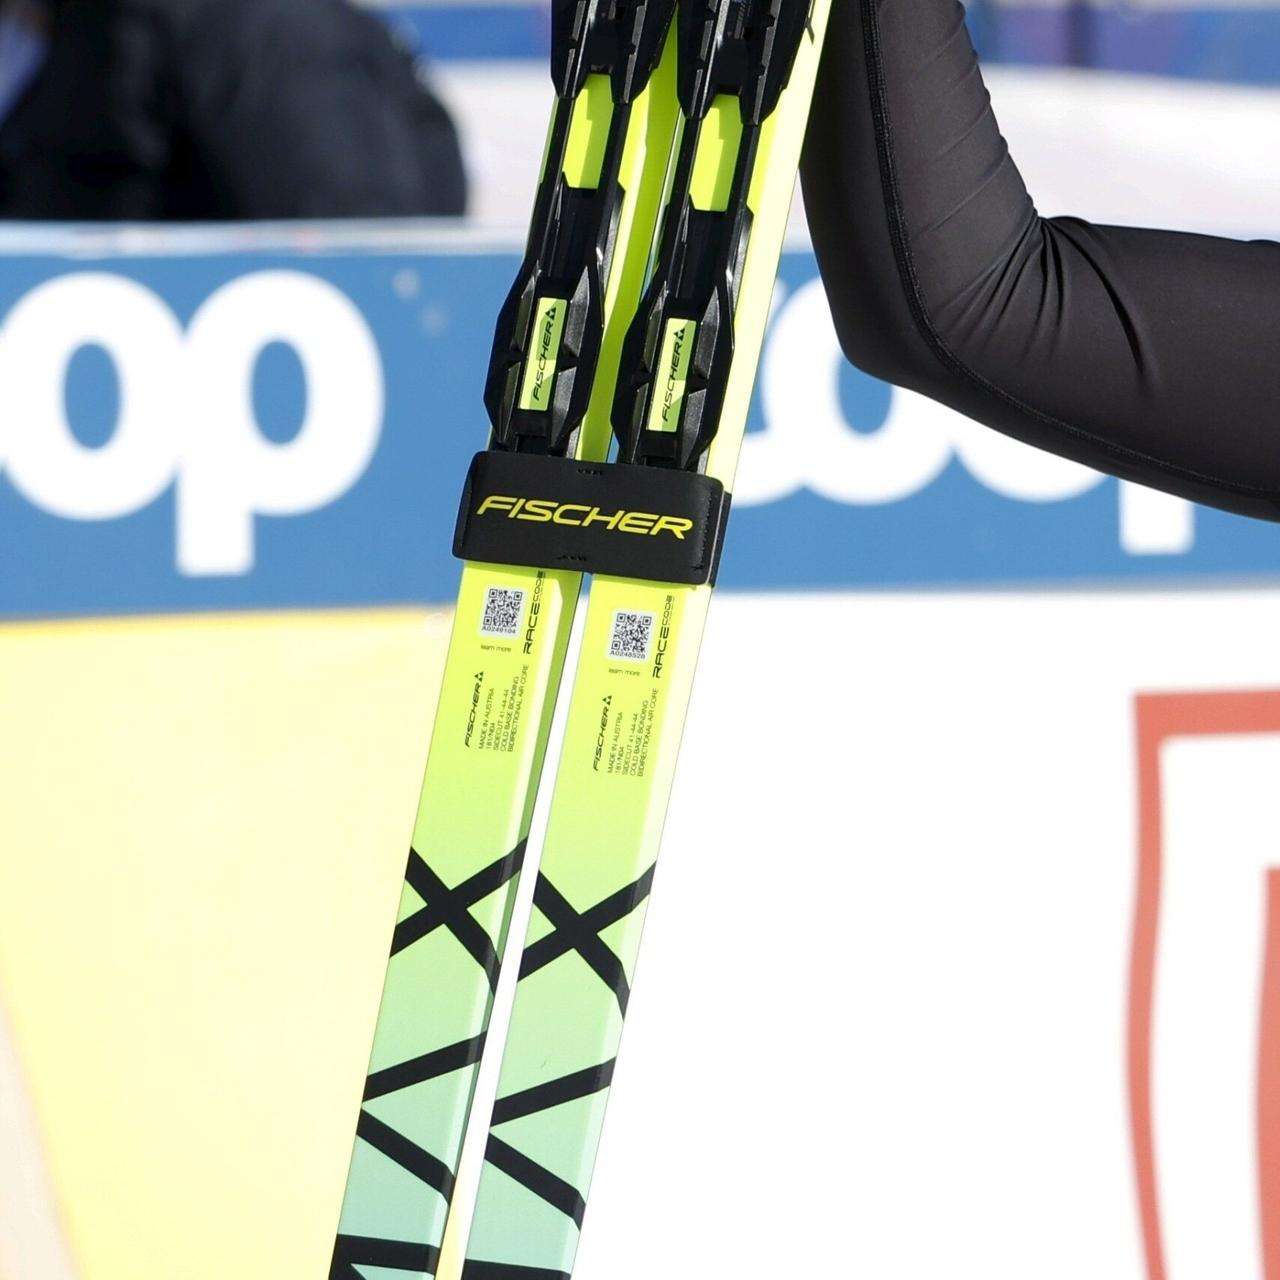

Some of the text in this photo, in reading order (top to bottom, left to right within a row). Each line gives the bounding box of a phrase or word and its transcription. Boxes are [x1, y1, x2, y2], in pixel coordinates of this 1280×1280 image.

[532, 319, 556, 401] FISCHER
[660, 341, 683, 423] FISCHER
[476, 494, 694, 540] FISCHER
[465, 683, 481, 747] FISCHER
[478, 728, 486, 749] MADE
[484, 688, 494, 718] AUSTRIA
[593, 706, 609, 771] FISCHER
[613, 712, 623, 742] AUSTRIA
